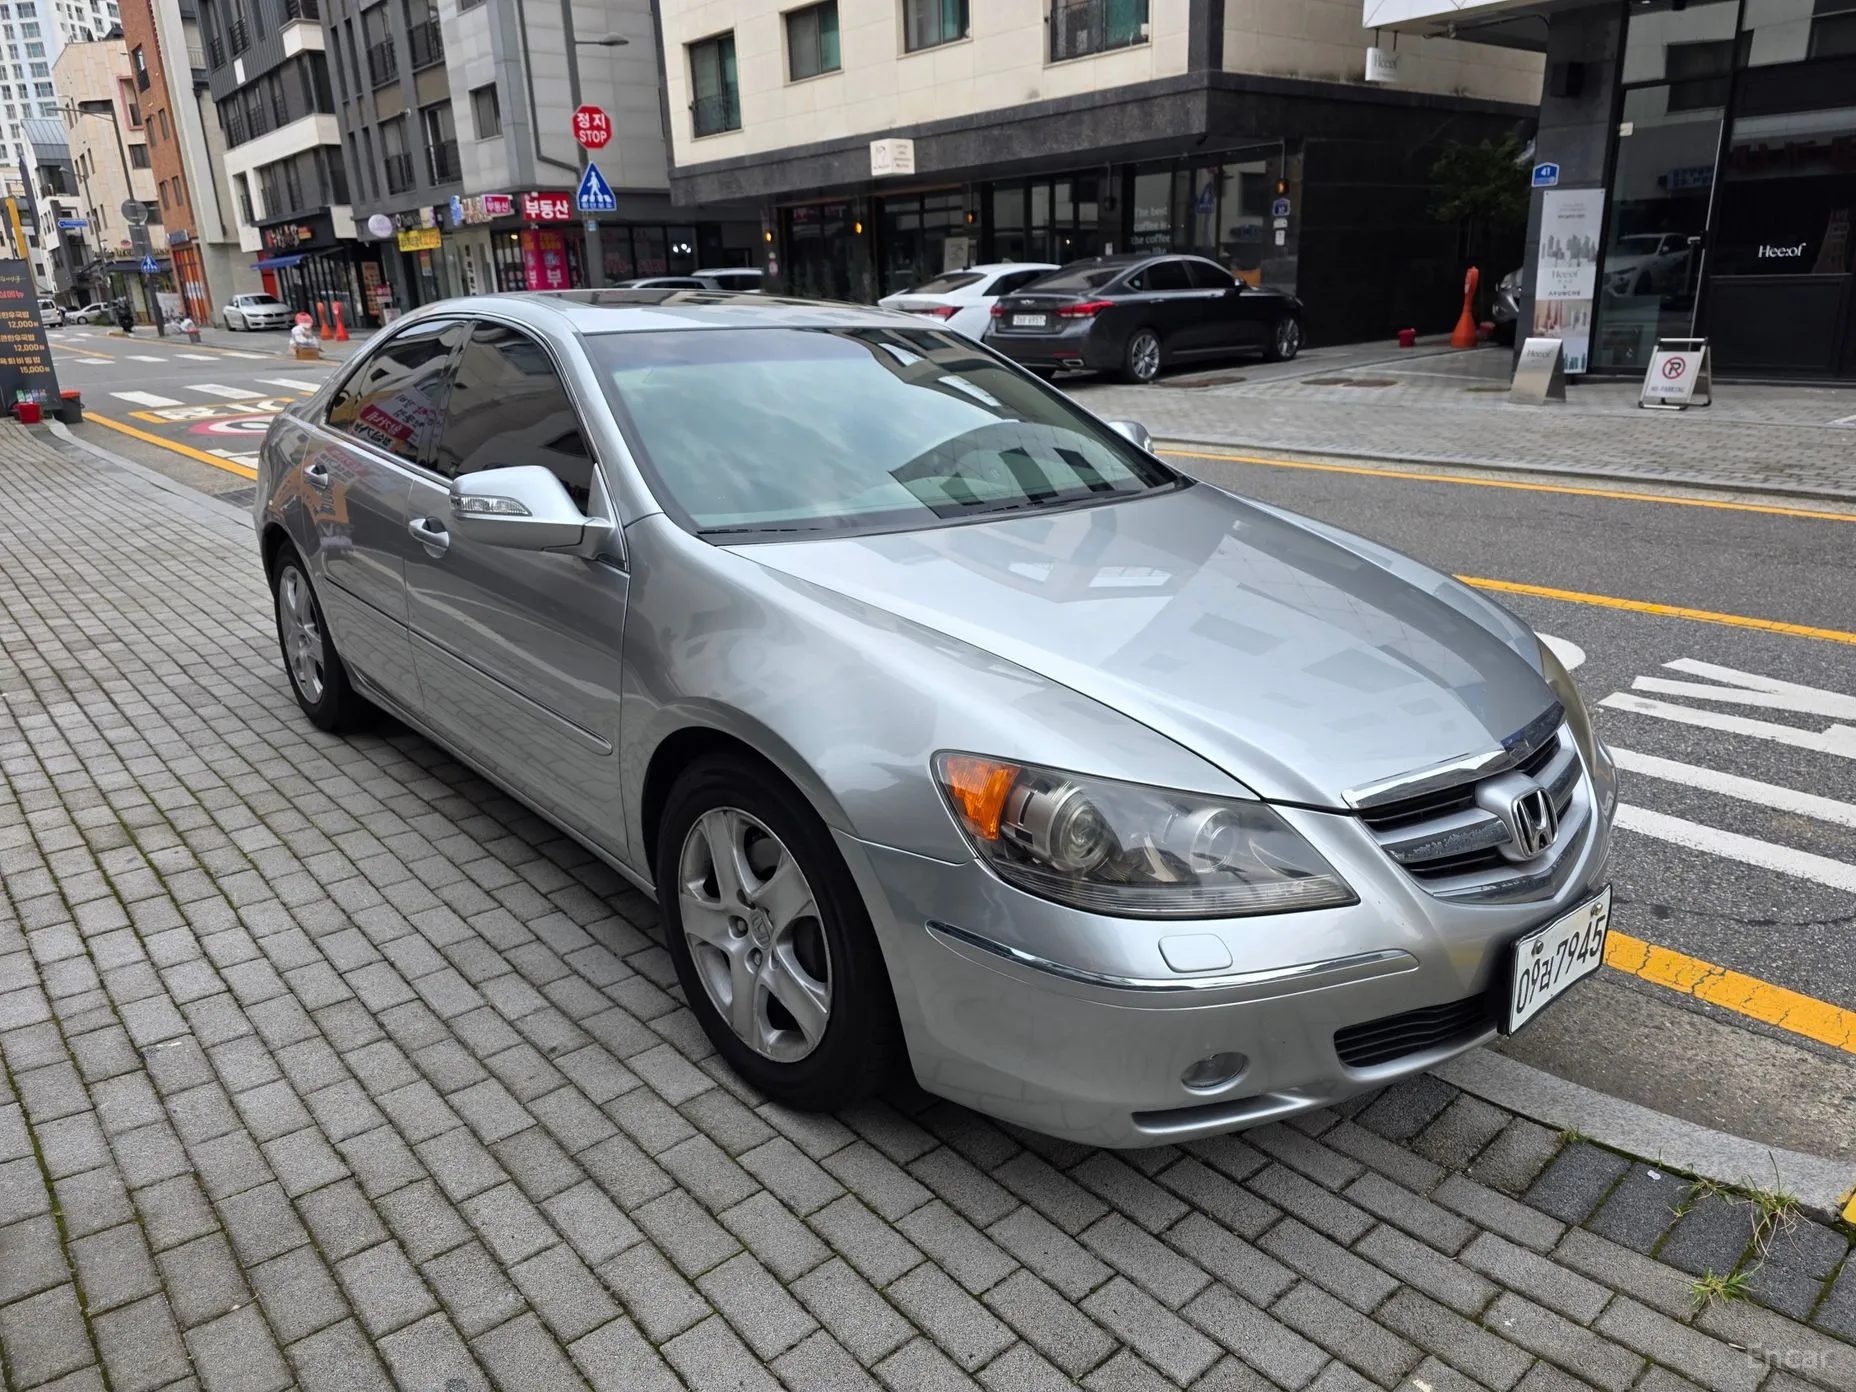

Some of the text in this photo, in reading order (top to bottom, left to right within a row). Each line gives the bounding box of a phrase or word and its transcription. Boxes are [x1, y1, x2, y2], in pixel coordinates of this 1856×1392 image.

[576, 112, 606, 129] 정지
[578, 130, 608, 144] STOP
[1540, 166, 1551, 177] 41
[525, 199, 570, 220] 부동산
